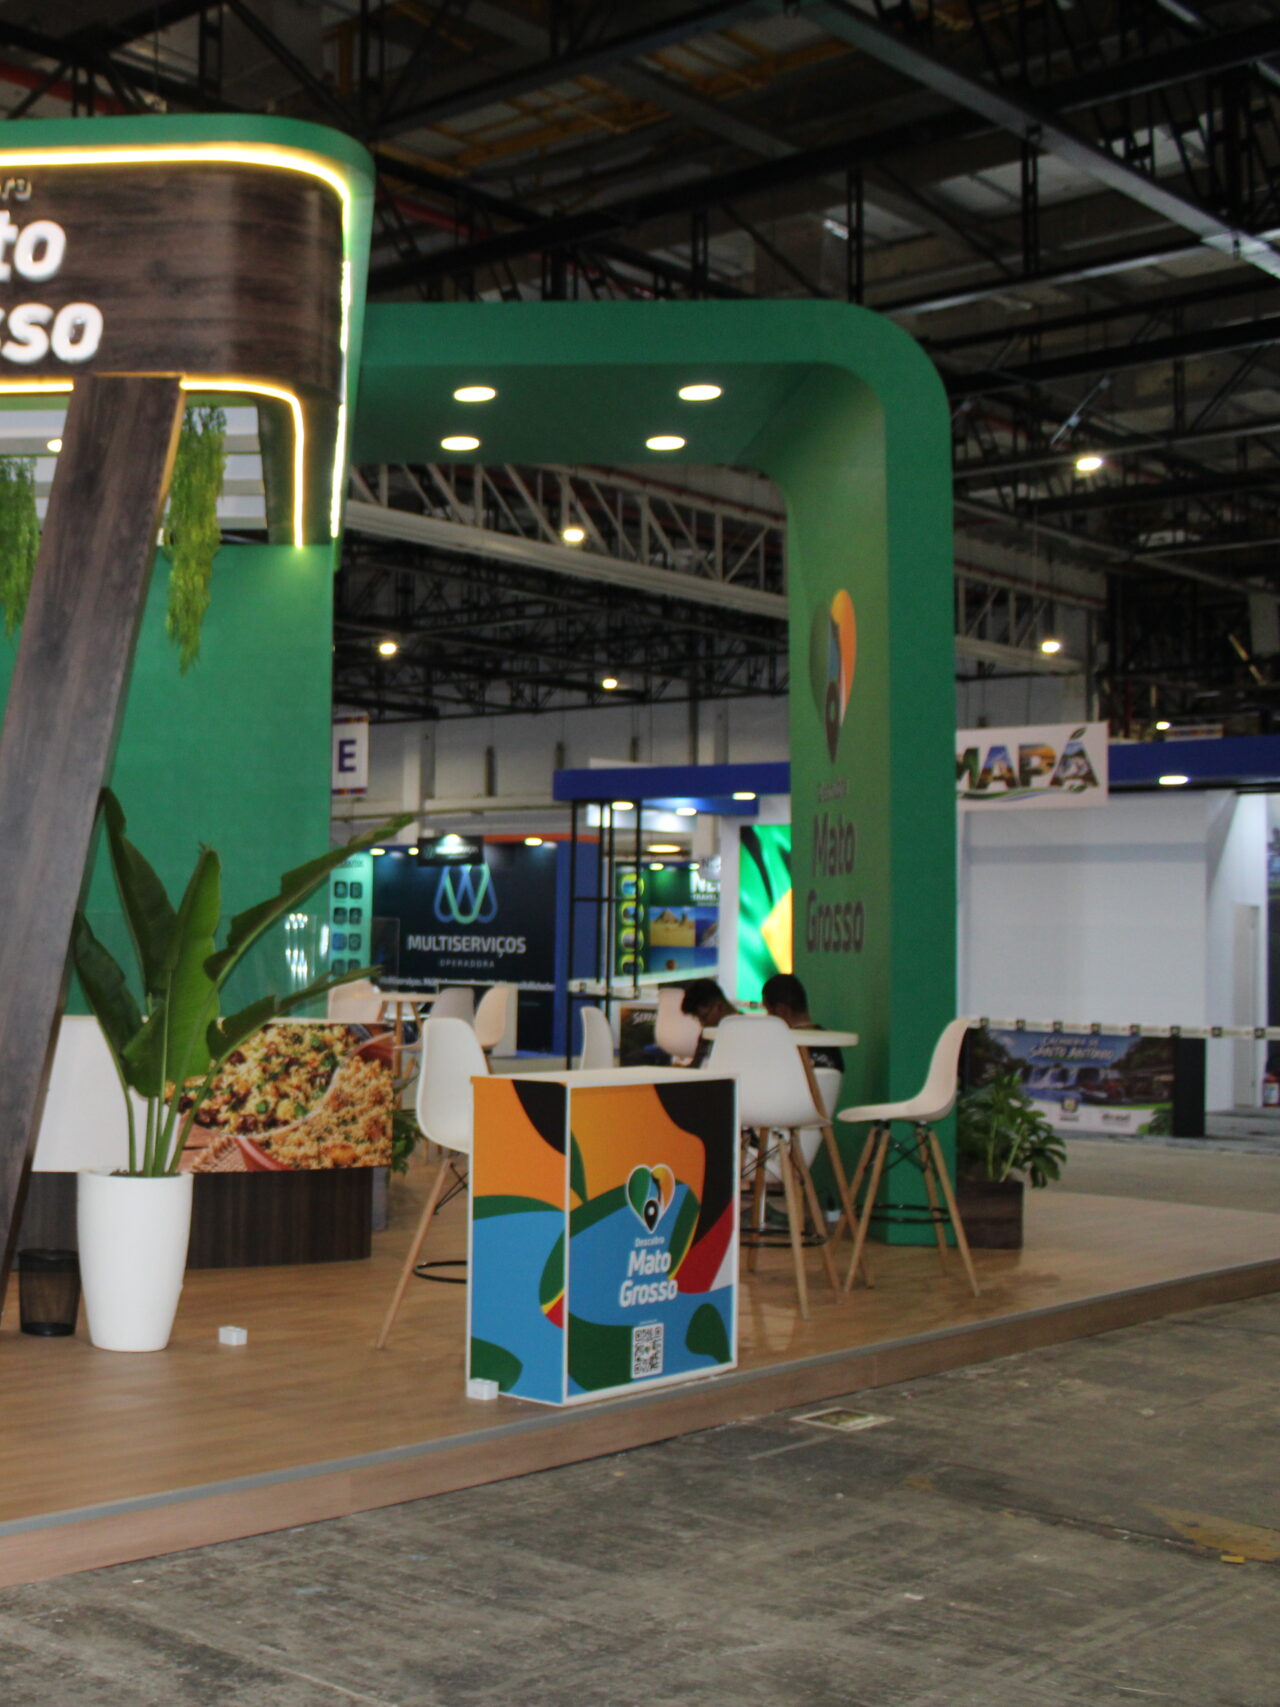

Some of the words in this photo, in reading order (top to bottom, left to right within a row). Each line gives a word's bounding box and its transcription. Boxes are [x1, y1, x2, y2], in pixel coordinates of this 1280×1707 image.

[338, 740, 357, 773] E
[813, 813, 856, 878] Mato
[807, 889, 864, 952] Grosso
[407, 934, 527, 958] MULTISERVIÇOS
[439, 959, 495, 969] OPERADORA
[627, 1249, 672, 1277] Mato
[620, 1279, 678, 1308] Grosso
